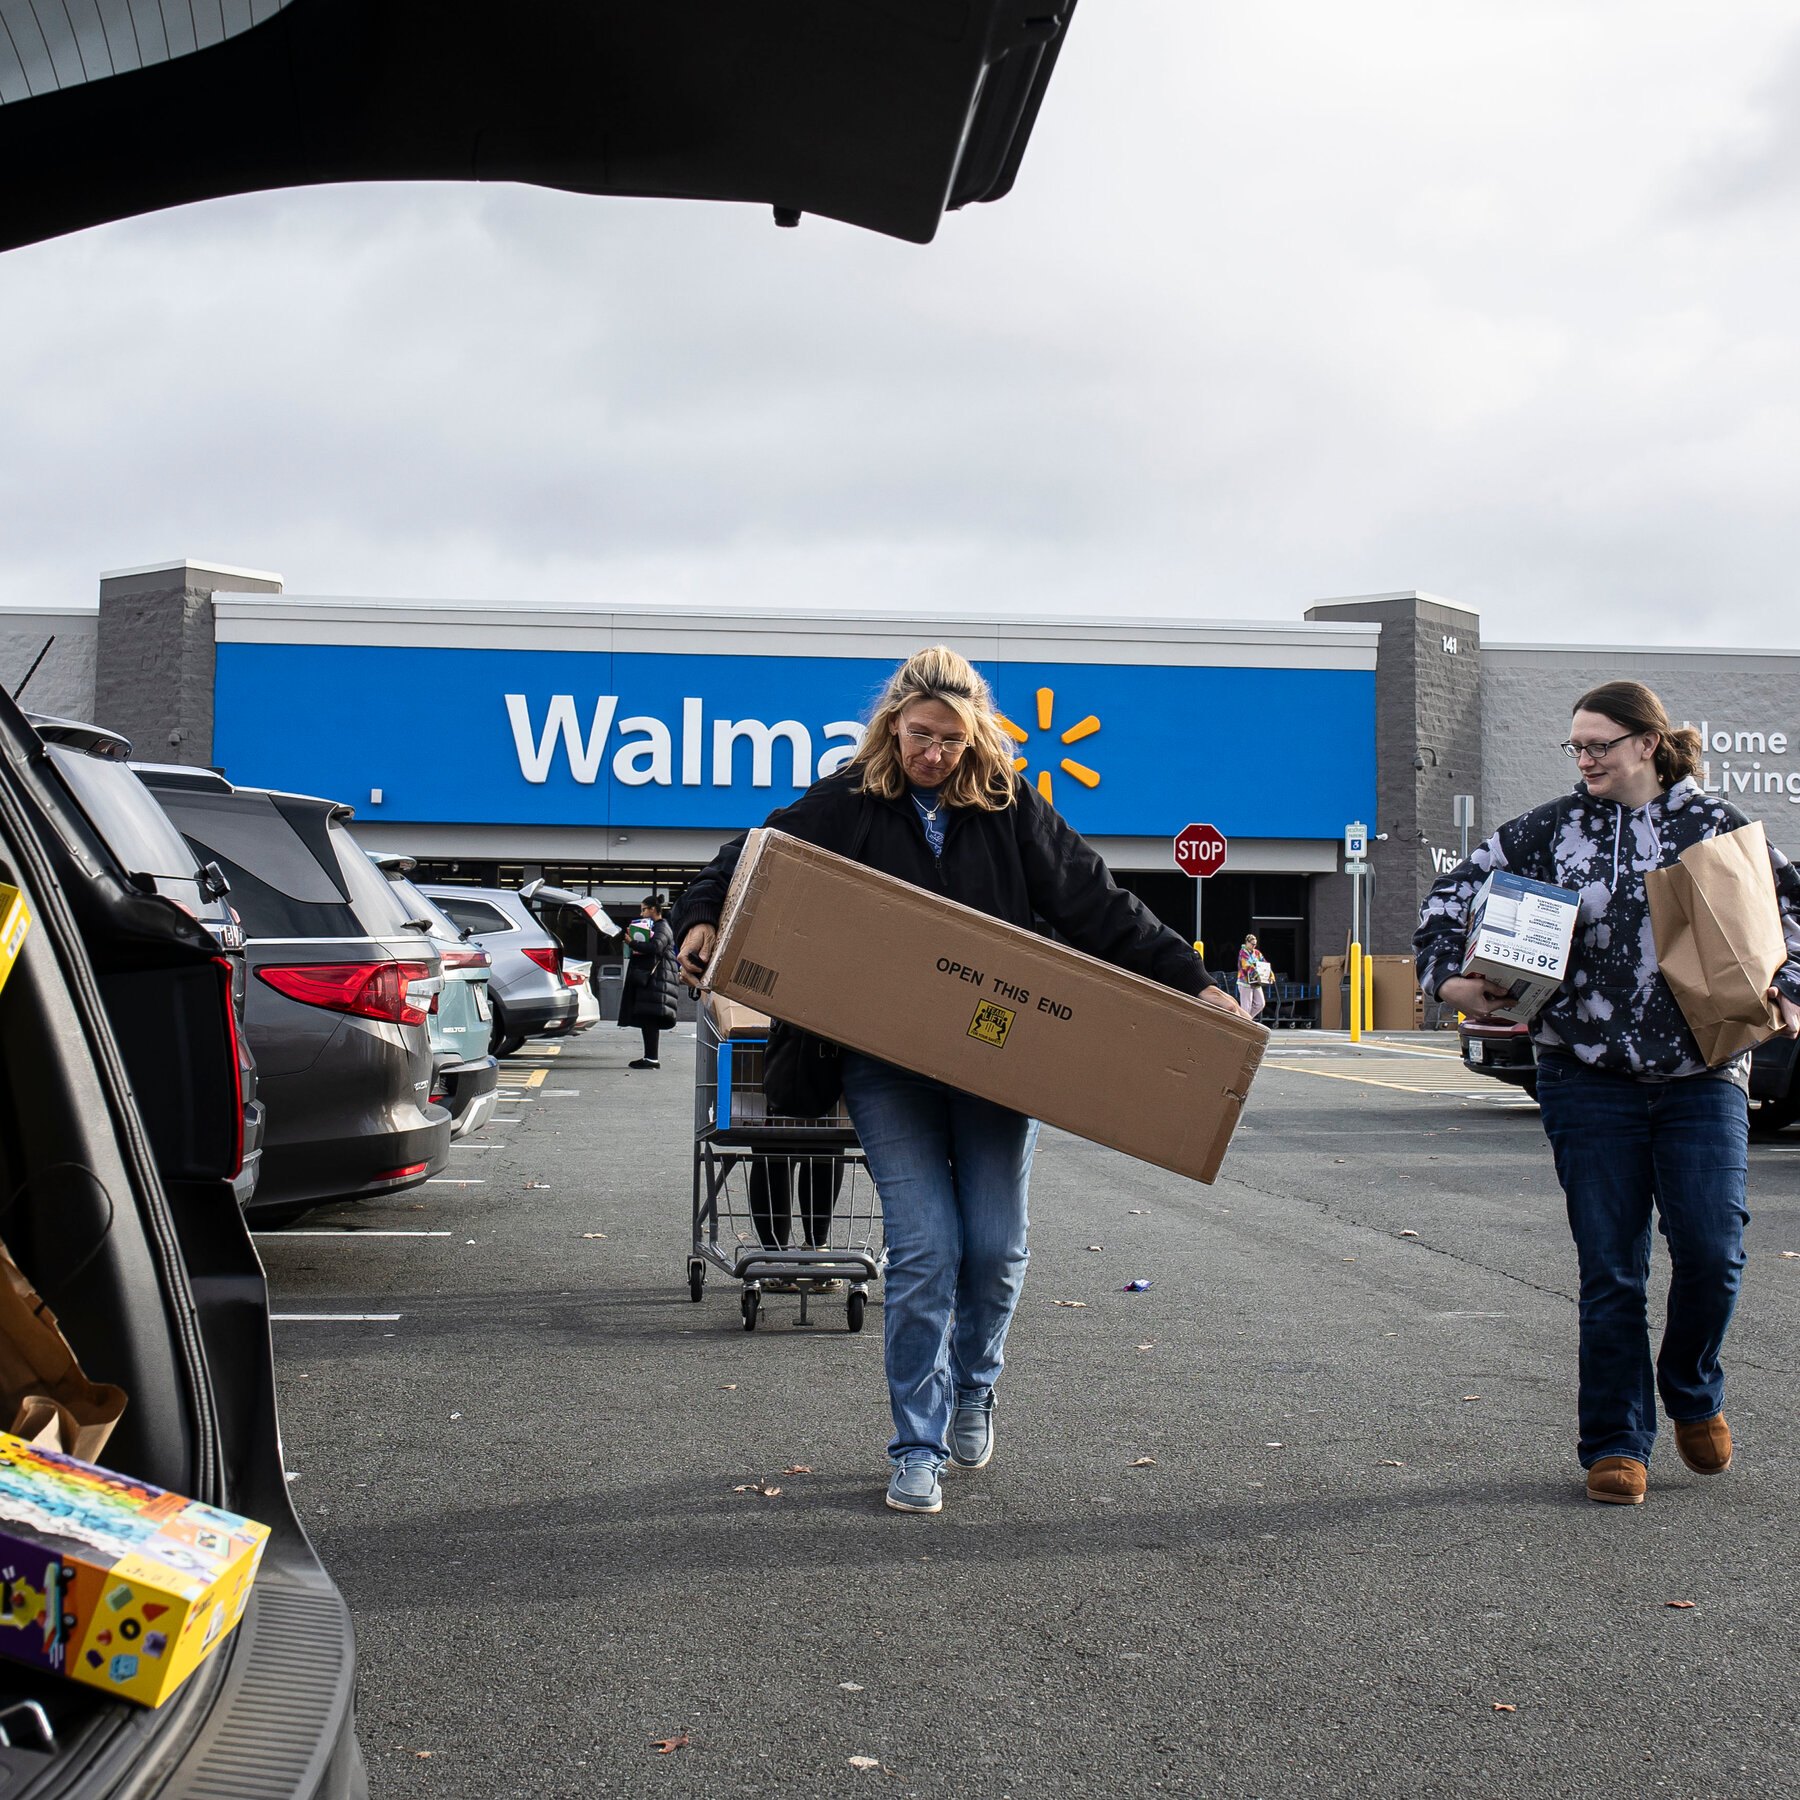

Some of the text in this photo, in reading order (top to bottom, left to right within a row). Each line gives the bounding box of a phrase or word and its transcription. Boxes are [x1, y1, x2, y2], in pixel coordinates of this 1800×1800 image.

[1442, 635, 1457, 655] 141
[504, 693, 868, 788] Walma
[1177, 840, 1223, 861] STOP
[1430, 847, 1463, 874] Visi
[1482, 943, 1558, 970] 26 PIÈCES
[936, 957, 1073, 1021] OPEN THIS END
[982, 1011, 1004, 1025] LIFT
[986, 1004, 1005, 1018] TEAM
